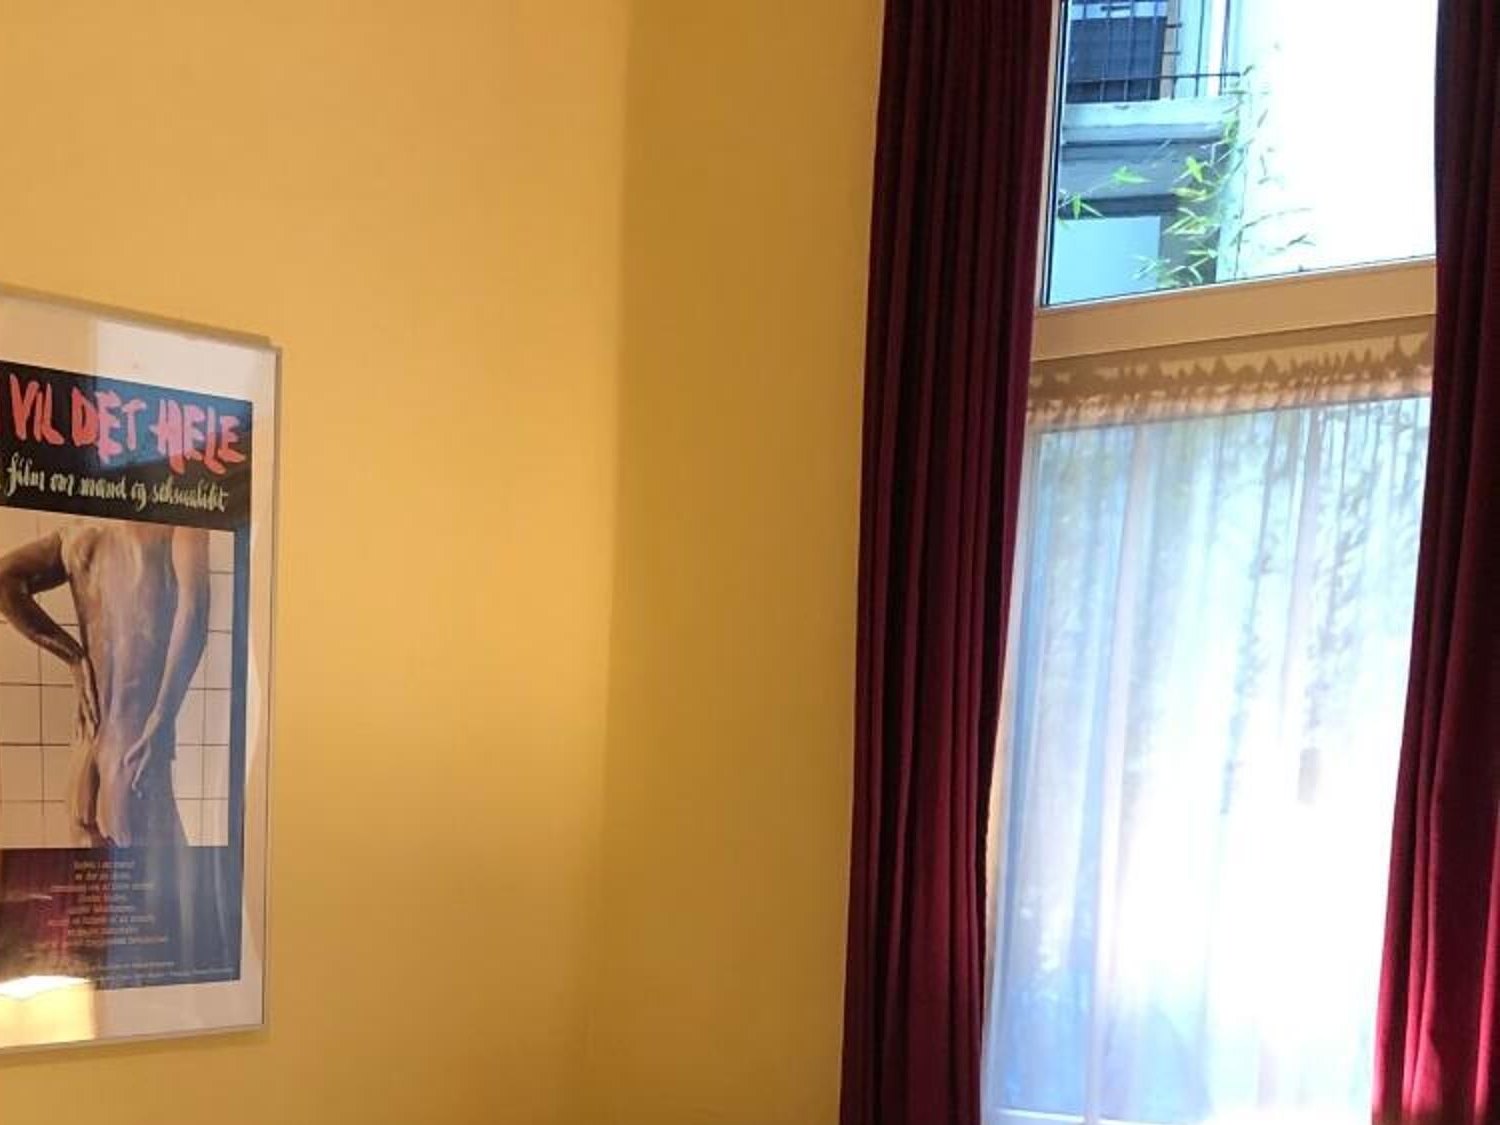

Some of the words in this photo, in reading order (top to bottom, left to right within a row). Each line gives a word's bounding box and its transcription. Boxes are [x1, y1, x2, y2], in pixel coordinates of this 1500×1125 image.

[10, 373, 65, 445] VIL
[72, 386, 147, 464] DET
[149, 398, 246, 476] HELE
[6, 452, 45, 497] film
